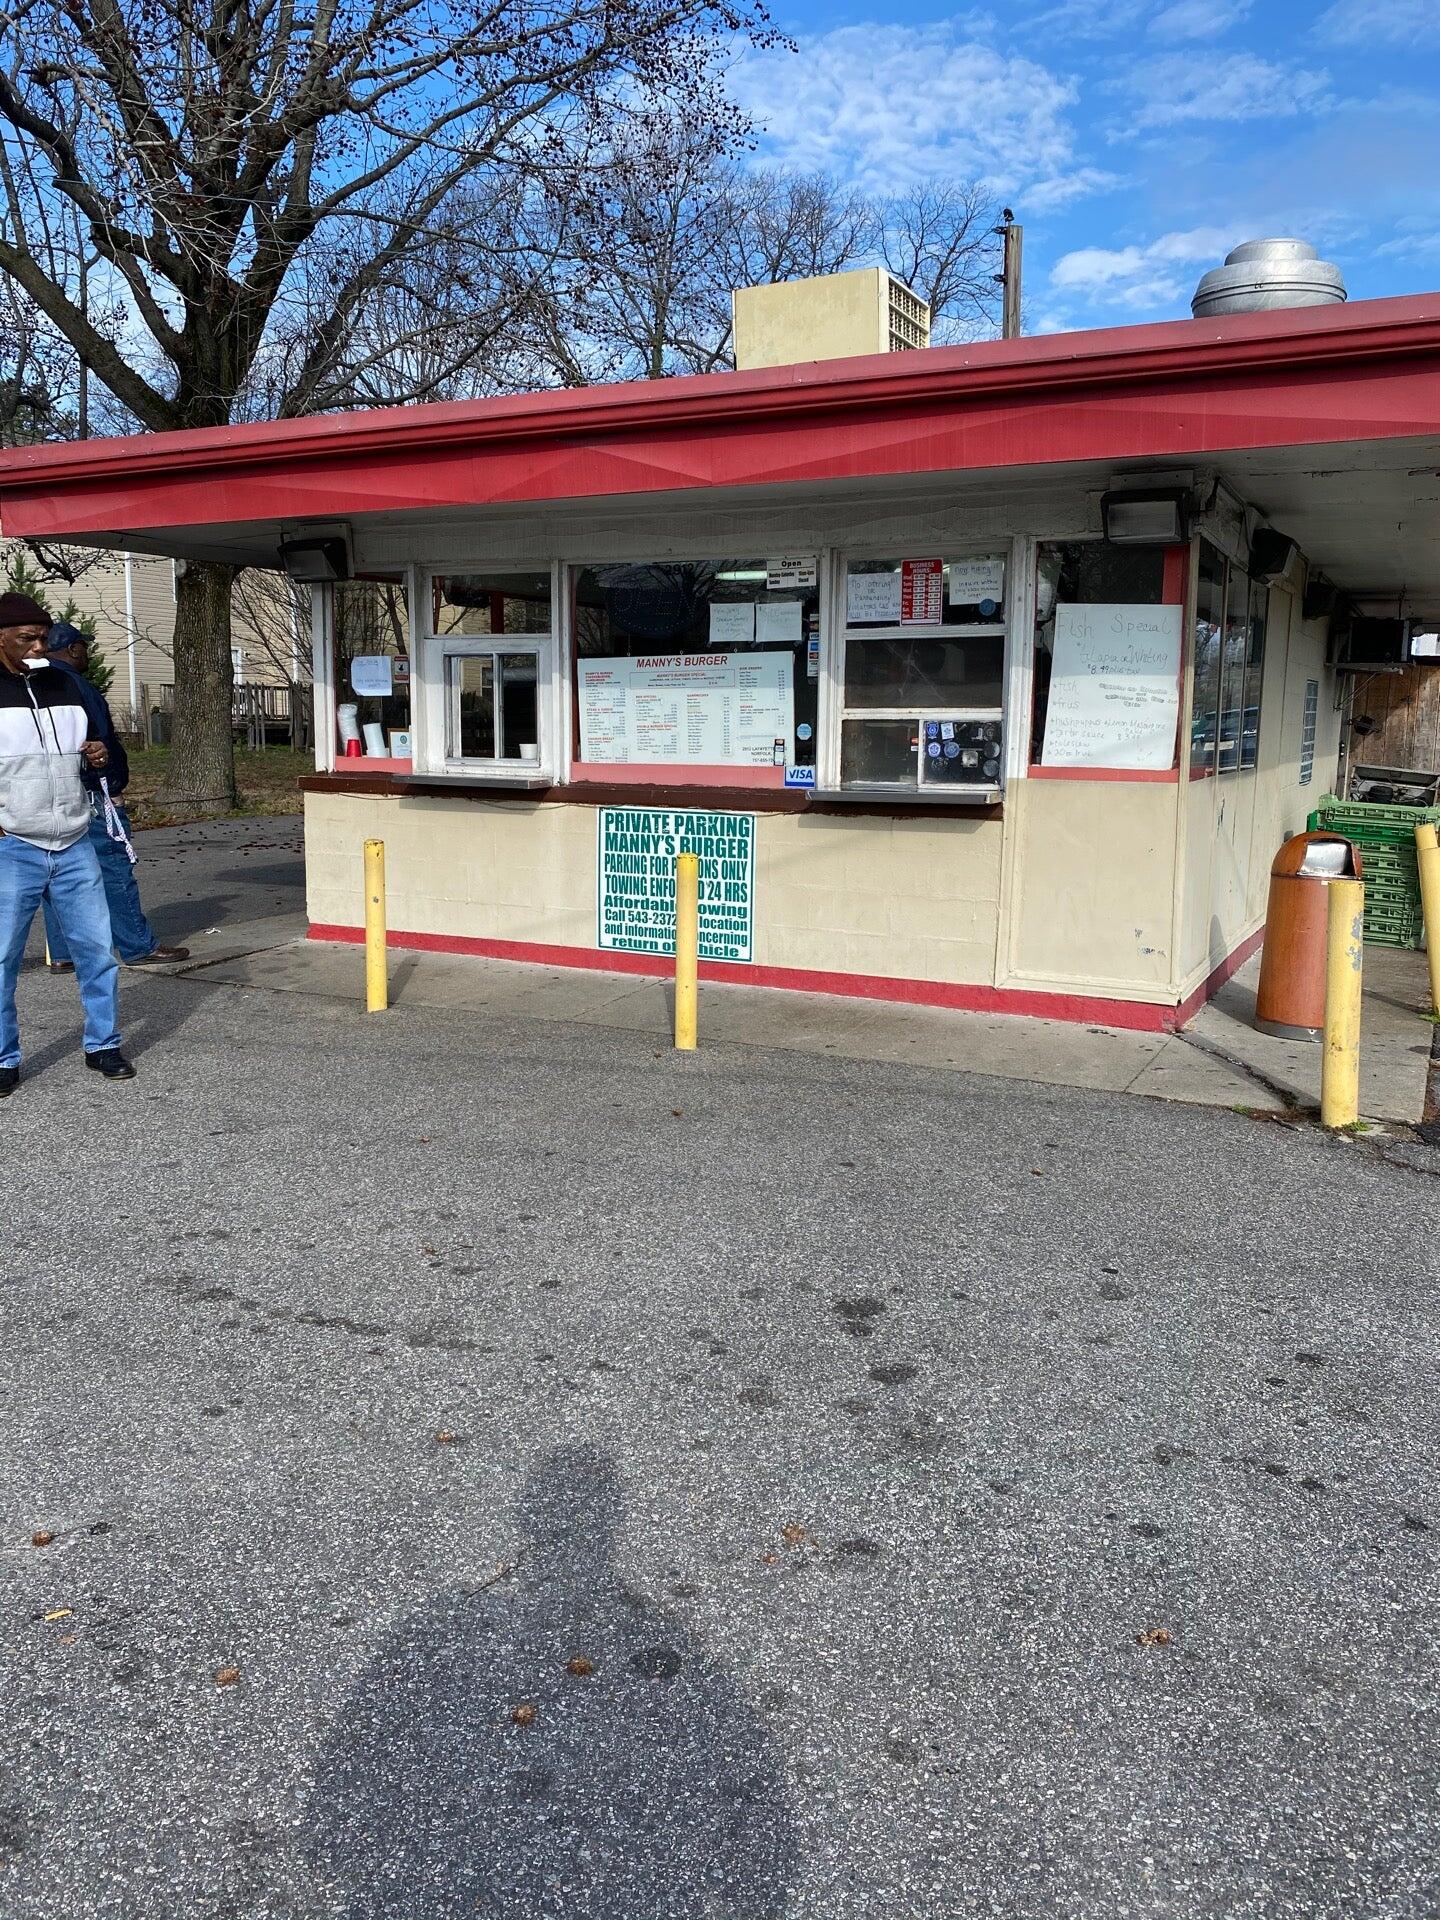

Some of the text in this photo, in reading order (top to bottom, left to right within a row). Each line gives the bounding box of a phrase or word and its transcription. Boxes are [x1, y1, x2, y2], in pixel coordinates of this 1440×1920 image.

[781, 560, 802, 568] Open
[1057, 611, 1172, 640] Fish Special
[636, 655, 728, 669] MANNY'S BURGER
[788, 769, 813, 780] VISA
[604, 812, 750, 838] PRIVATE PARKING
[604, 832, 749, 859] MANNY'S BURGER
[604, 853, 647, 875] PARKING
[650, 855, 669, 876] FOR
[721, 859, 748, 881] ONLY
[604, 874, 748, 903] TOWING ENFOD 24 HRS
[604, 909, 625, 922] Call
[700, 916, 748, 931] location
[697, 903, 748, 919] owing
[604, 923, 623, 935] and
[624, 923, 676, 940] informatio
[612, 936, 659, 951] return
